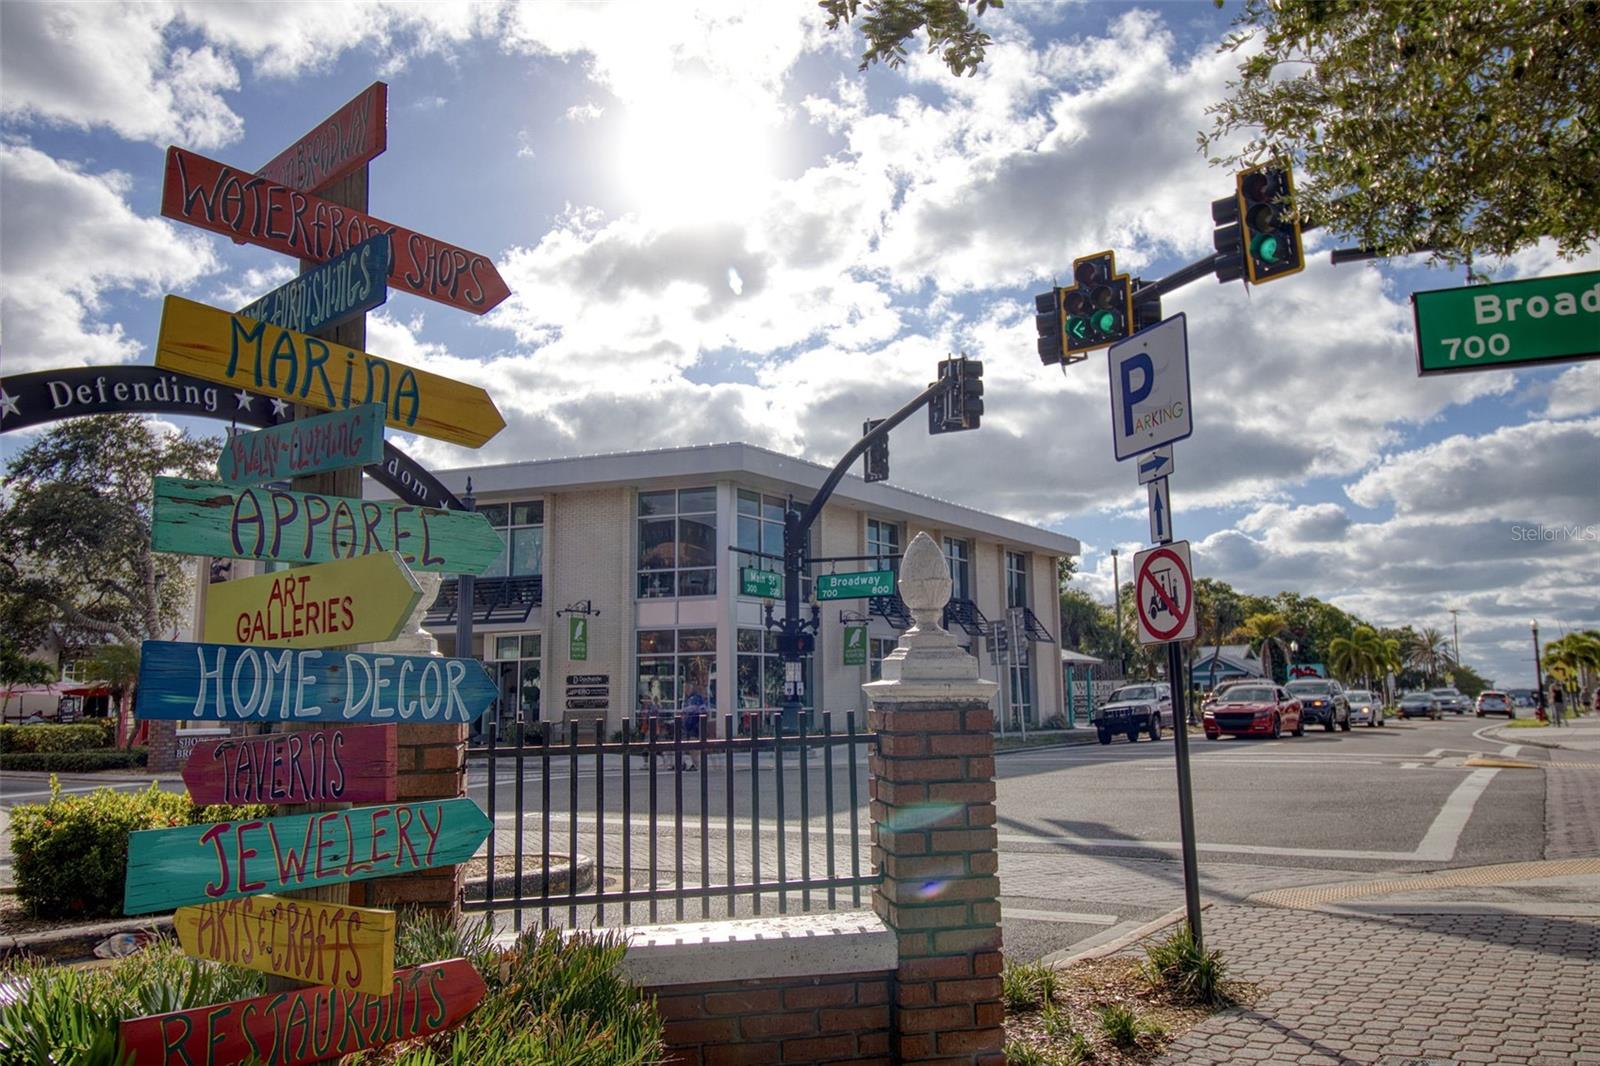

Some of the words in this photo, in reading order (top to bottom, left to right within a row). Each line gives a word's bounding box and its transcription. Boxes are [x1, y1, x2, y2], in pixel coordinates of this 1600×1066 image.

[405, 233, 486, 305] SHOPS
[1441, 333, 1510, 361] 700
[47, 376, 219, 411] Defending
[231, 488, 446, 566] APPAREL
[267, 575, 311, 609] ART
[750, 571, 766, 584] Main
[822, 589, 838, 598] 700
[830, 574, 880, 587] Broadway
[236, 596, 354, 643] GALLERIES
[192, 646, 323, 719] HOME
[342, 653, 471, 722] DECOR
[199, 804, 443, 898] JEWELERY
[197, 898, 254, 964] ARTS
[270, 901, 362, 988] CRAFTS
